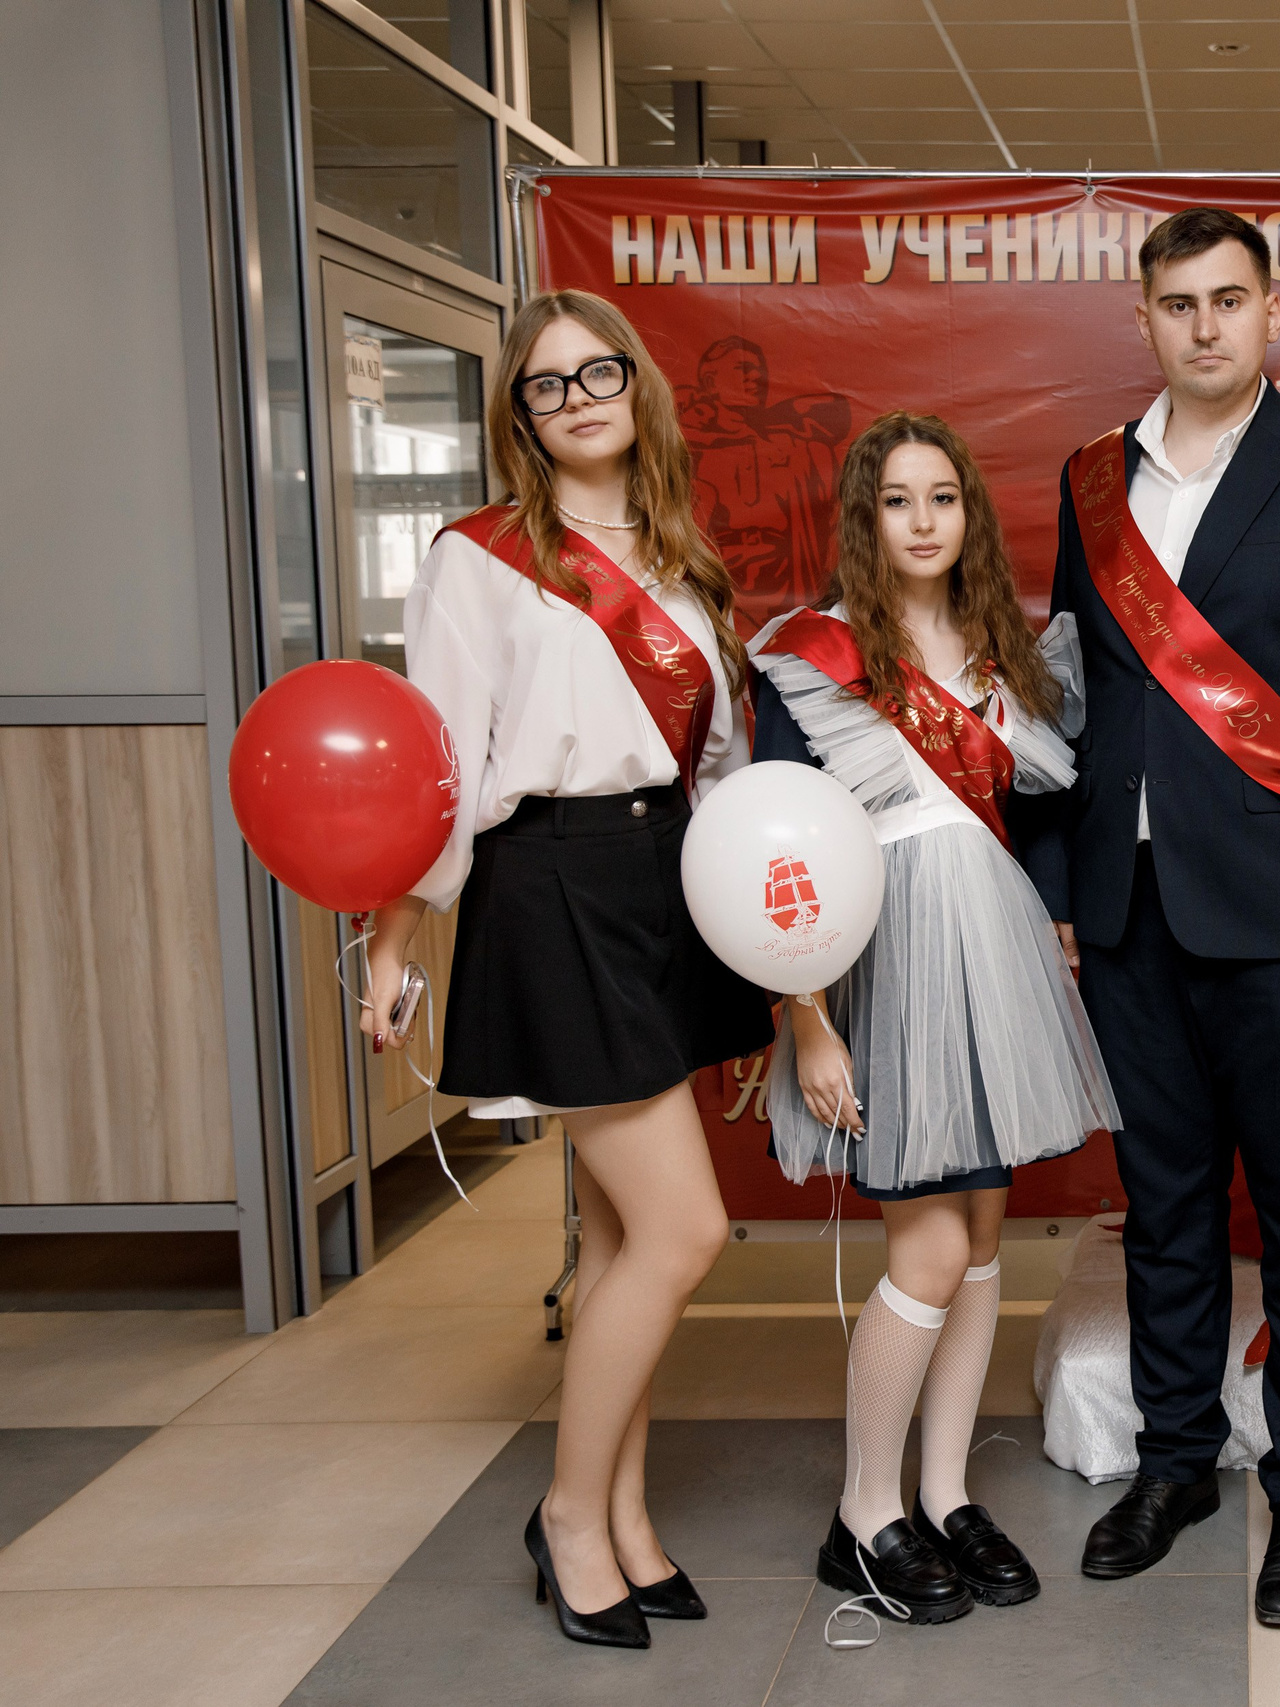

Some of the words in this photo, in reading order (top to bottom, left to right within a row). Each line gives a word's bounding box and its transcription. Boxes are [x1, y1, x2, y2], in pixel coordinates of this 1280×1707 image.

[612, 214, 818, 284] НАШИ
[1091, 500, 1150, 583] Классный
[1117, 572, 1206, 680] руководитель
[1197, 672, 1274, 740] 2025
[918, 711, 940, 732] класс
[767, 945, 815, 963] добрый
[818, 931, 843, 954] путь
